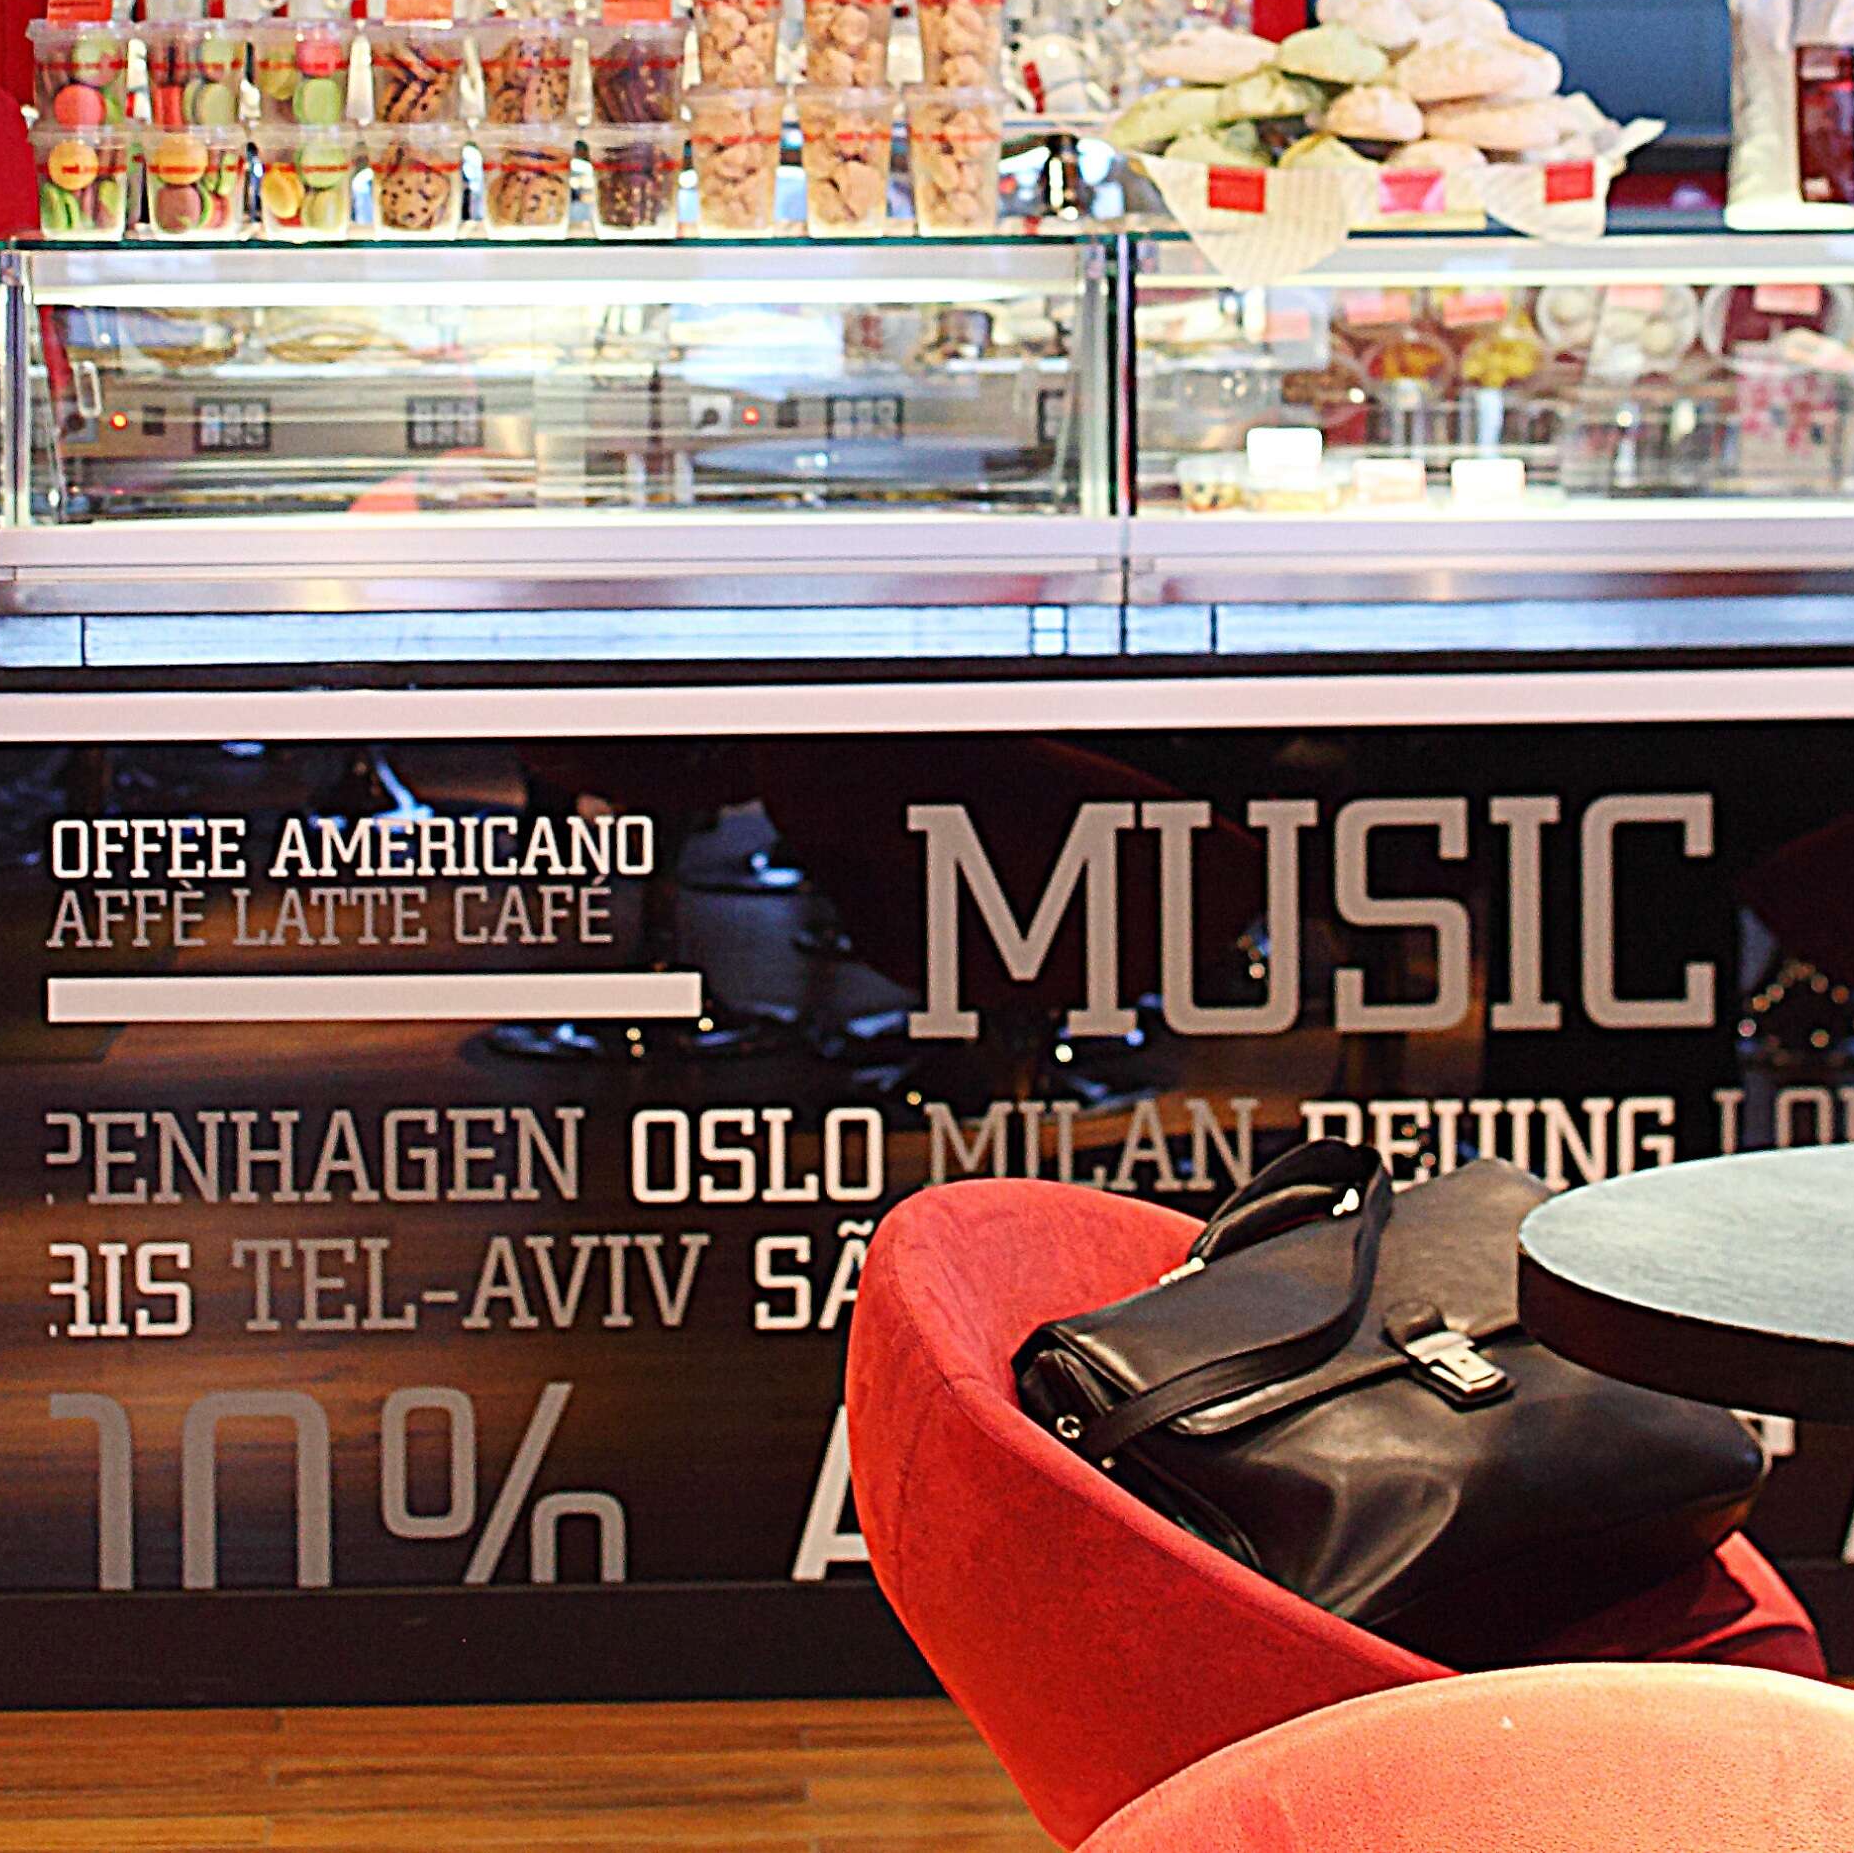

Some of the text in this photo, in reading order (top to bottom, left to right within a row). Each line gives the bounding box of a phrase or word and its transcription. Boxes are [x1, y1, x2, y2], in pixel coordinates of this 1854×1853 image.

[51, 815, 655, 880] OFFEE AMERICANO
[46, 877, 614, 947] AFFÈ LATTE CAFÉ
[907, 794, 1717, 1039] MUSIC
[632, 1107, 883, 1203] OSLO
[925, 1099, 1255, 1191] MILAN
[232, 1235, 709, 1331] TEL-AVIV
